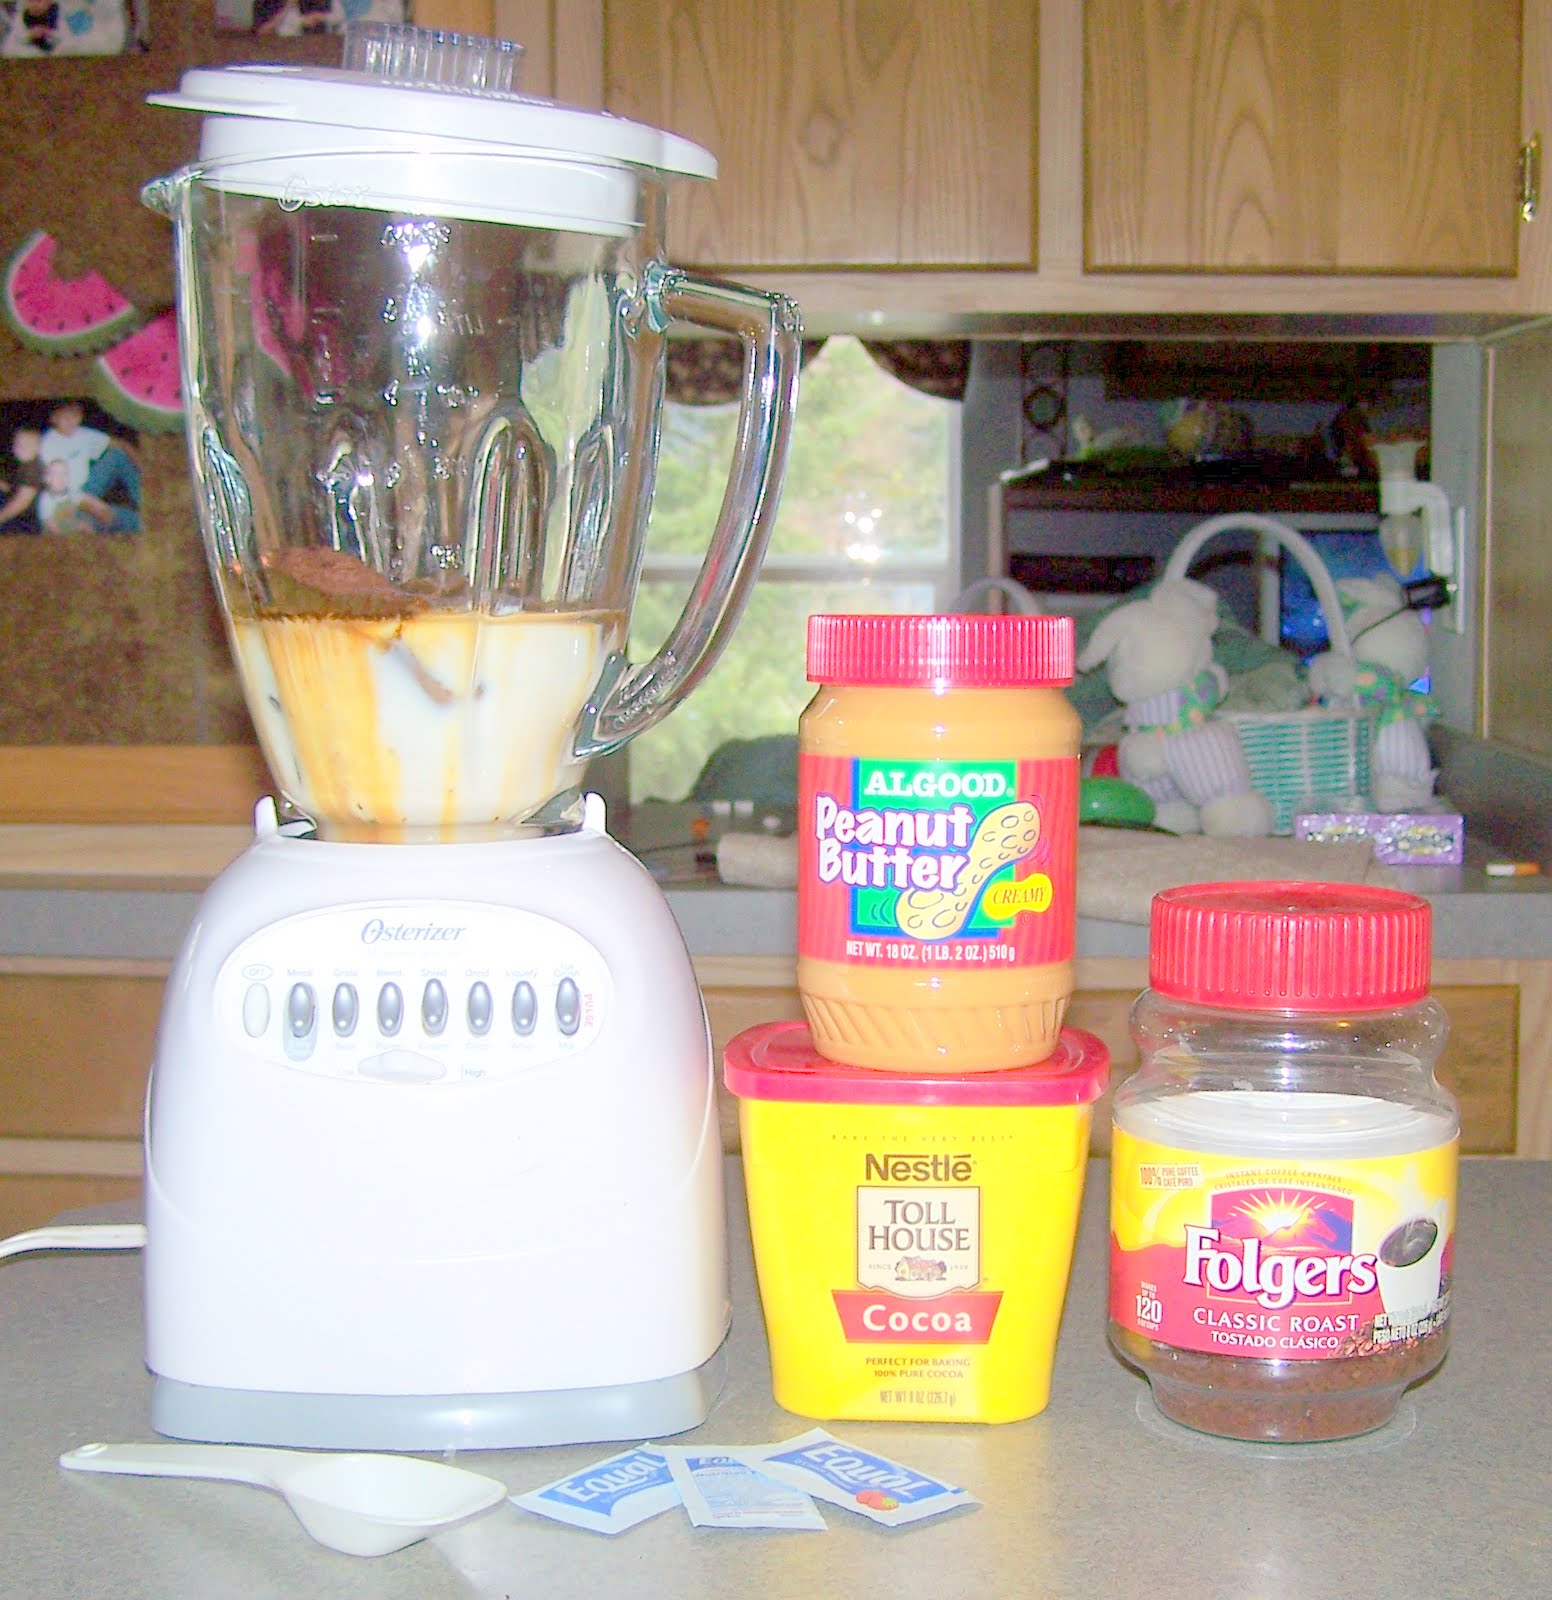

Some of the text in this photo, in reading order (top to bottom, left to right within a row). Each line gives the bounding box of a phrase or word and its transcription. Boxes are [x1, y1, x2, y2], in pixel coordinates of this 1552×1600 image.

[863, 771, 1007, 798] ALGOOD
[815, 795, 975, 848] Peanut
[818, 836, 968, 890] Butter
[992, 886, 1048, 906] CREAMY
[361, 918, 467, 944] Osterizer
[846, 939, 864, 956] NET
[865, 942, 883, 958] WT.
[886, 943, 899, 959] 18
[901, 944, 919, 960] OZ.
[935, 945, 953, 960] LB.
[955, 945, 963, 960] 2
[583, 993, 594, 1028] PULSE
[464, 1065, 487, 1078] High
[865, 1153, 972, 1183] Nestlé
[1225, 1169, 1261, 1180] INSTANT
[1265, 1168, 1297, 1176] COFFEE
[1213, 1179, 1256, 1190] CRISTALES
[1258, 1178, 1270, 1186] DE
[883, 1199, 956, 1225] TOLL
[868, 1225, 971, 1251] HOUSE
[1183, 1224, 1378, 1310] Folgers
[862, 1304, 973, 1332] Cocoa
[1135, 1294, 1163, 1324] 120
[1193, 1307, 1360, 1333] CLASSIC ROAST
[1211, 1330, 1339, 1350] TOSTADO CLÁSICO
[865, 1357, 971, 1367] PERFECT FOR BAKING
[874, 1369, 964, 1378] 100% PURE COCOA
